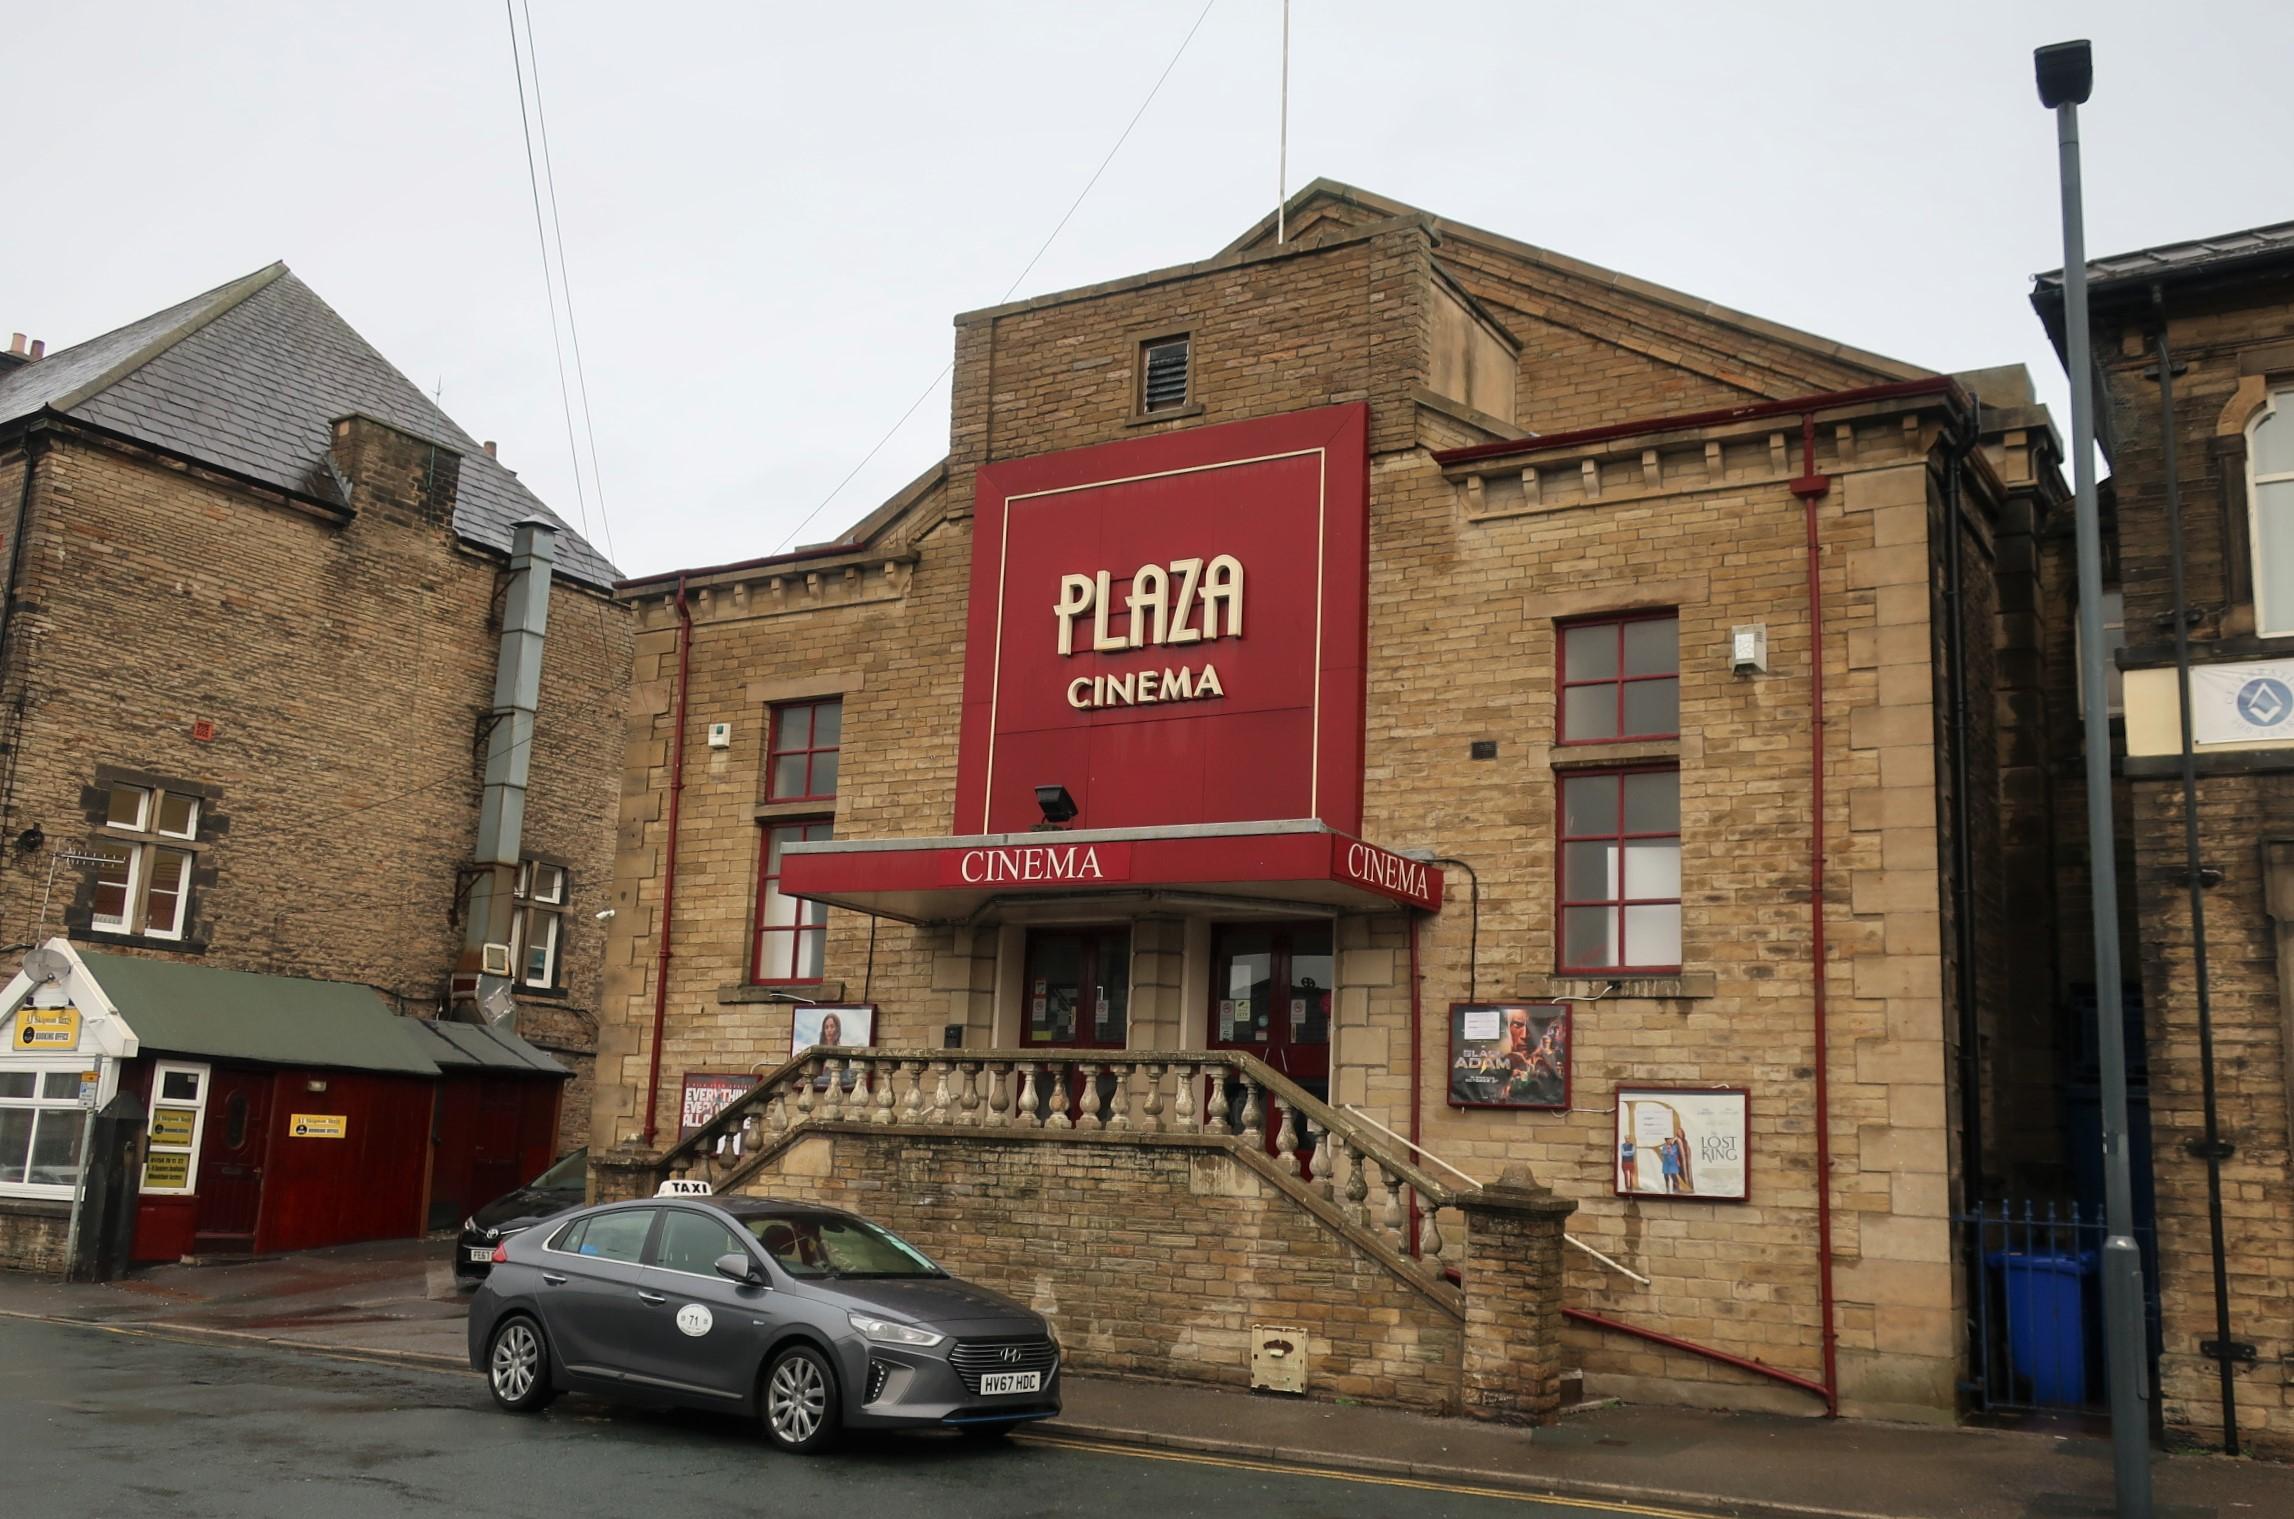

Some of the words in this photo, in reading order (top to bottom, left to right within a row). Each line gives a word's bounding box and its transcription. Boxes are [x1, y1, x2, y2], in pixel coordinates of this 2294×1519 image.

[1053, 554, 1243, 655] PLAZA
[1067, 664, 1224, 708] CINEMA
[961, 846, 1103, 882] CINEMA
[1347, 843, 1429, 899] CINEMA
[35, 1032, 54, 1040] BOOKING
[55, 1032, 69, 1040] OFFICE
[1454, 1056, 1511, 1070] ADAM
[685, 1087, 748, 1102] EVERYTHIN
[682, 1113, 703, 1128] ALL
[1701, 1135, 1737, 1150] LOST
[1702, 1148, 1738, 1163] KING
[672, 1182, 707, 1193] TAXI
[689, 1314, 699, 1326] 71
[985, 1375, 1014, 1392] HV67
[1016, 1374, 1036, 1390] HDC
